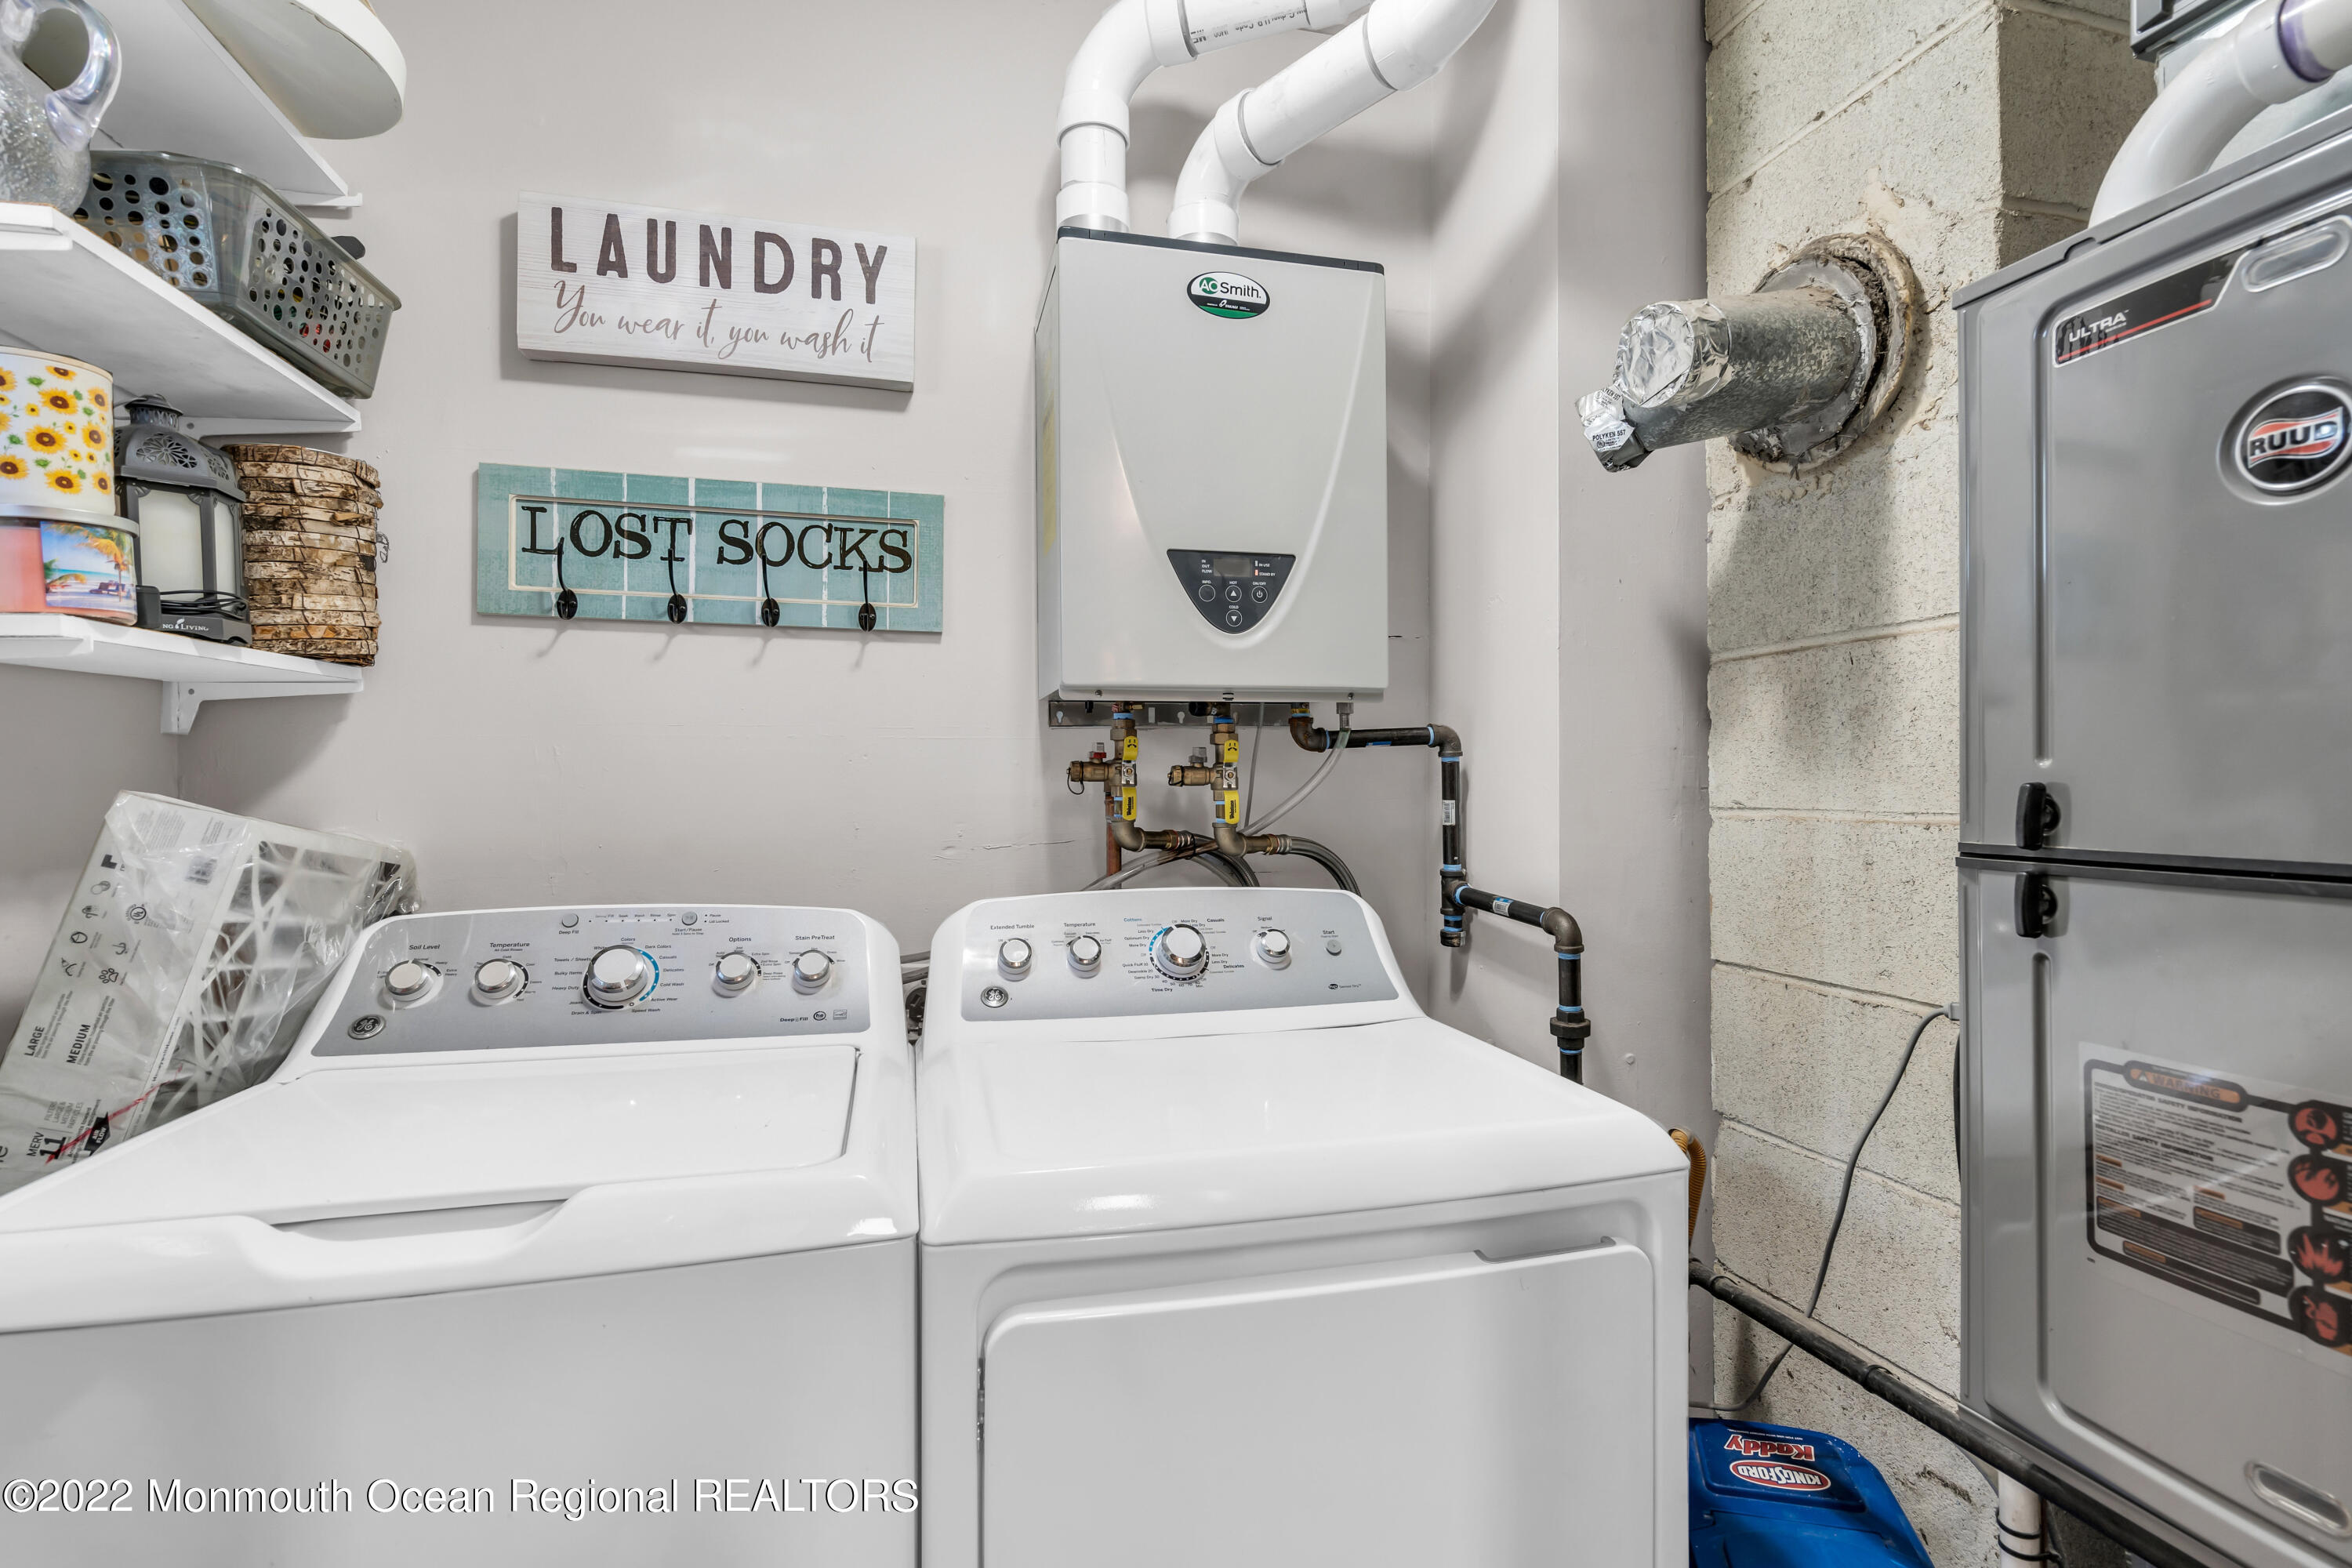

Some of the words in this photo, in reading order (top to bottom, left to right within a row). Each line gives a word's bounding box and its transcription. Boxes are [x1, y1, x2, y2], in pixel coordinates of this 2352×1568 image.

[550, 207, 887, 305] LAUNDRY
[1200, 278, 1218, 293] AO
[553, 280, 606, 333] You
[618, 315, 686, 340] wear
[717, 326, 770, 359] you
[779, 308, 853, 359] wash
[861, 315, 885, 363] it
[2069, 312, 2126, 343] ULTRA
[1592, 431, 1615, 441] POLYKEN
[2250, 421, 2338, 457] RUUD
[521, 506, 693, 563] LOST
[717, 519, 913, 574] SOCKS
[24, 1026, 45, 1056] LARGE
[66, 1024, 91, 1064] MEDIUM
[2153, 1073, 2221, 1099] WARNING
[44, 1101, 58, 1121] FILTERS
[52, 1106, 64, 1123] LARGE
[60, 1103, 73, 1125] MEDIUM
[67, 1102, 84, 1129] PARTICLES
[81, 1107, 92, 1125] toward
[26, 1131, 45, 1157] MERV
[92, 1129, 100, 1140] AIR
[96, 1127, 107, 1144] FLOW
[40, 1137, 67, 1160] 11
[1724, 1434, 1815, 1461] Kaddy
[1737, 1465, 1821, 1485] KINGSFORD
